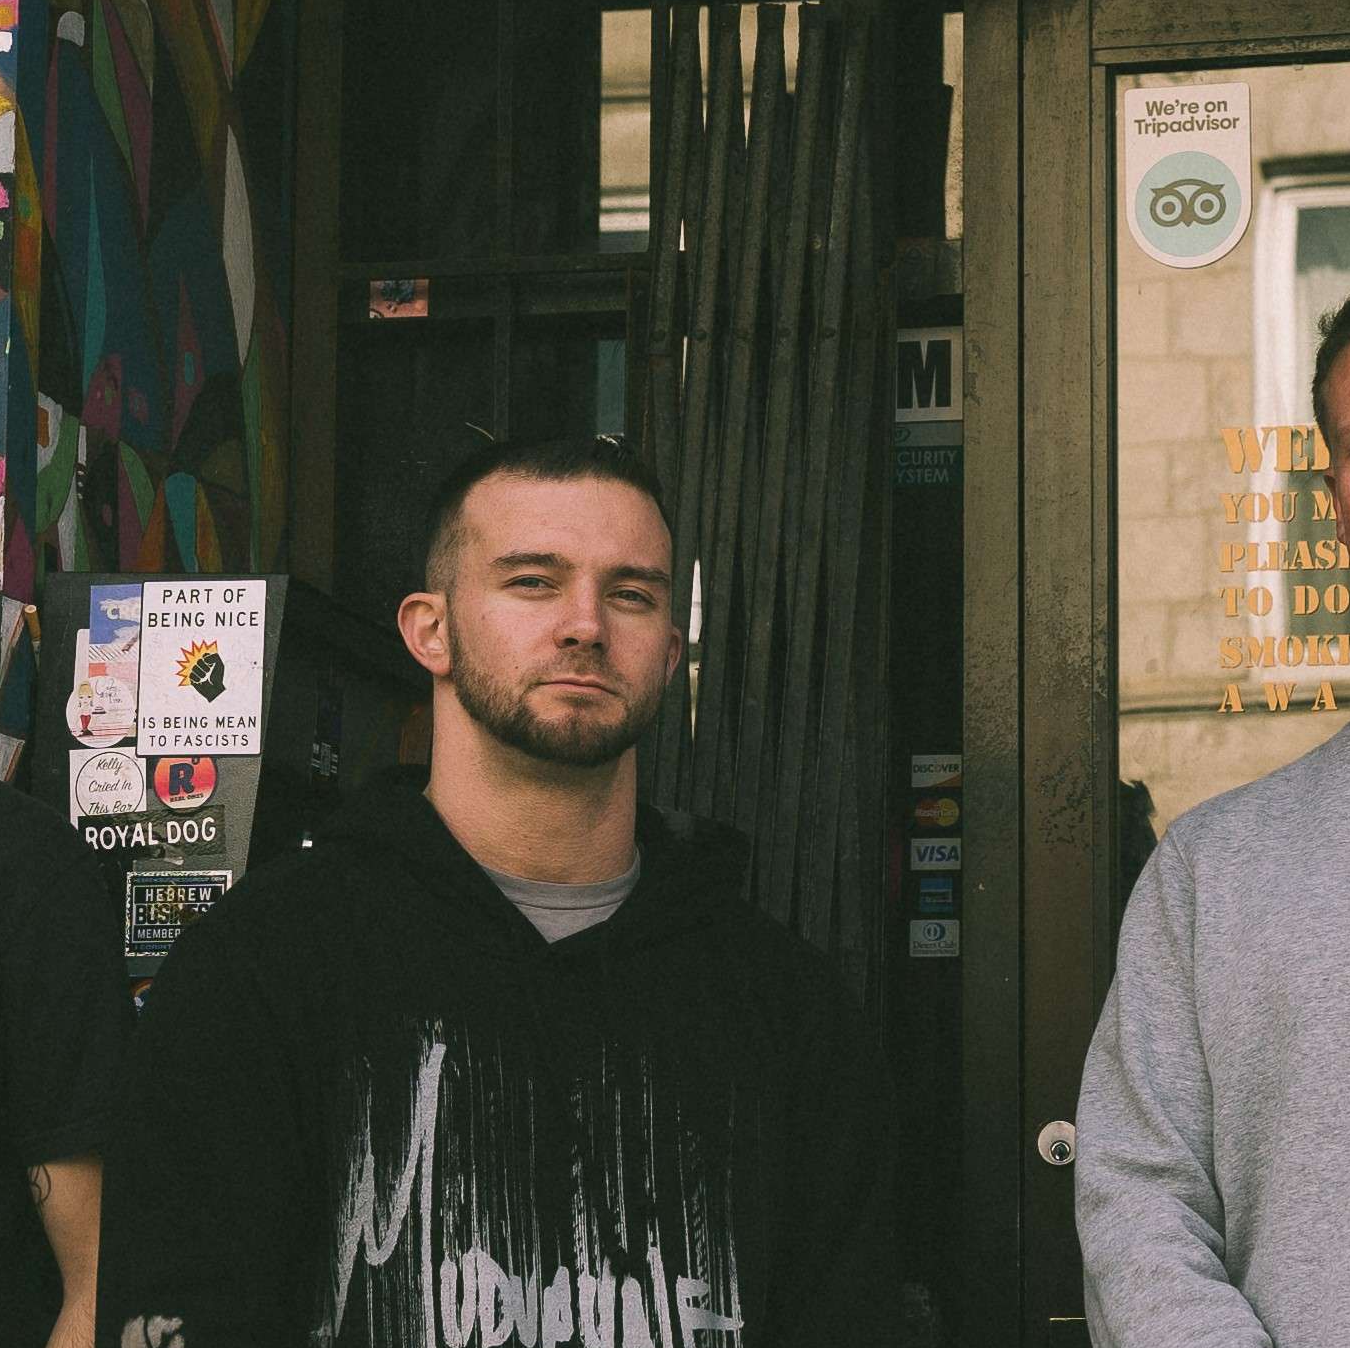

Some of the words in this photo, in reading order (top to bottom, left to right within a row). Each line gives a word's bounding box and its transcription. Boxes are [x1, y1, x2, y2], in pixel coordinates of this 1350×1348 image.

[1145, 99, 1199, 116] We're
[1204, 100, 1228, 113] on
[1134, 114, 1240, 137] Tripadvisor
[898, 450, 957, 466] CURITY
[895, 468, 950, 484] YSTEM
[1220, 492, 1298, 523] YOU
[162, 588, 213, 603] PART
[223, 588, 246, 603] OF
[1218, 585, 1274, 618] TO
[148, 612, 205, 627] BEING
[215, 611, 259, 627] NICE
[142, 717, 156, 729] IS
[163, 716, 208, 729] BEING
[215, 716, 257, 728] MEAN
[149, 735, 167, 747] TO
[174, 734, 249, 747] FASCISTS
[96, 759, 123, 774] Kelly
[913, 764, 960, 774] DISCOVER
[88, 780, 118, 793] Cried
[88, 802, 109, 814] This
[112, 800, 133, 814] Bar
[85, 822, 159, 850] ROYAL
[166, 817, 216, 844] DOG
[916, 845, 959, 862] VISA
[145, 887, 212, 902] HEBREW
